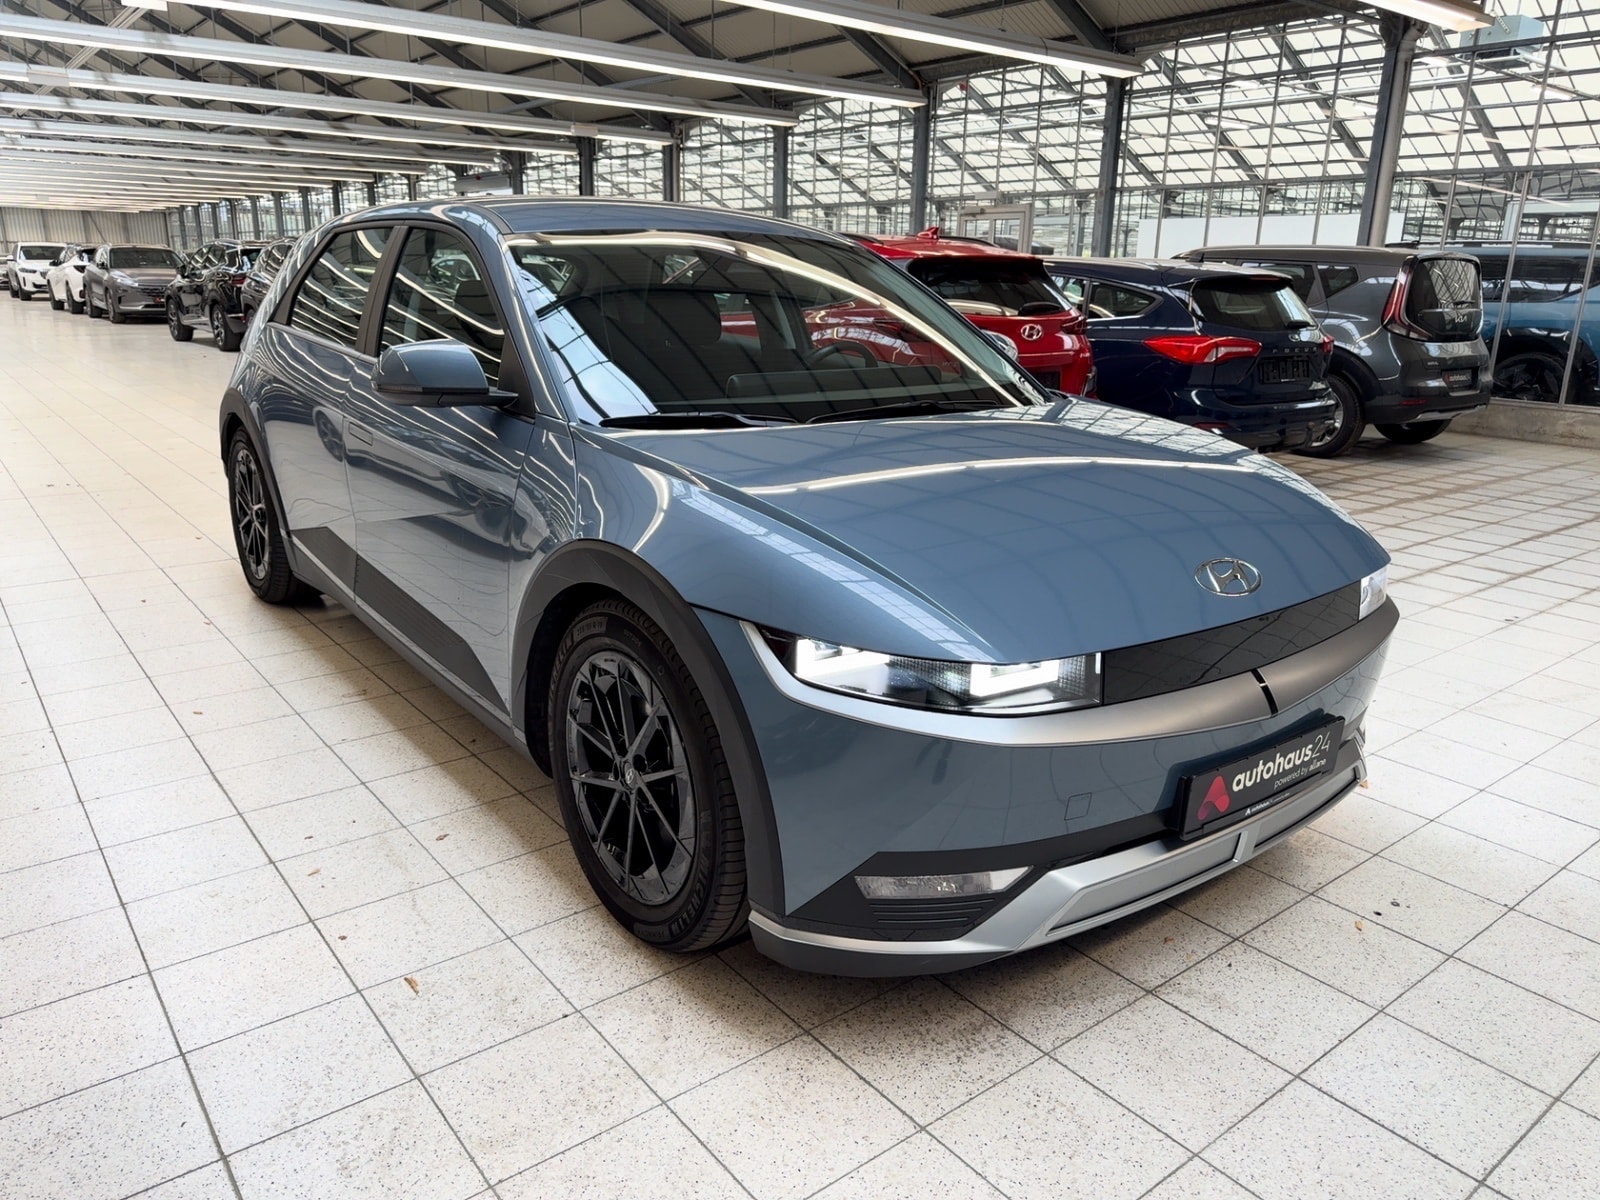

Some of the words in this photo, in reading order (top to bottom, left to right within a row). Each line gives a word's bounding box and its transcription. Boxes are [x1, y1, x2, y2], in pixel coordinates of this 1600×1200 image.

[1232, 731, 1331, 793] autohaus24
[1273, 769, 1301, 790] powered
[1301, 764, 1309, 777] by
